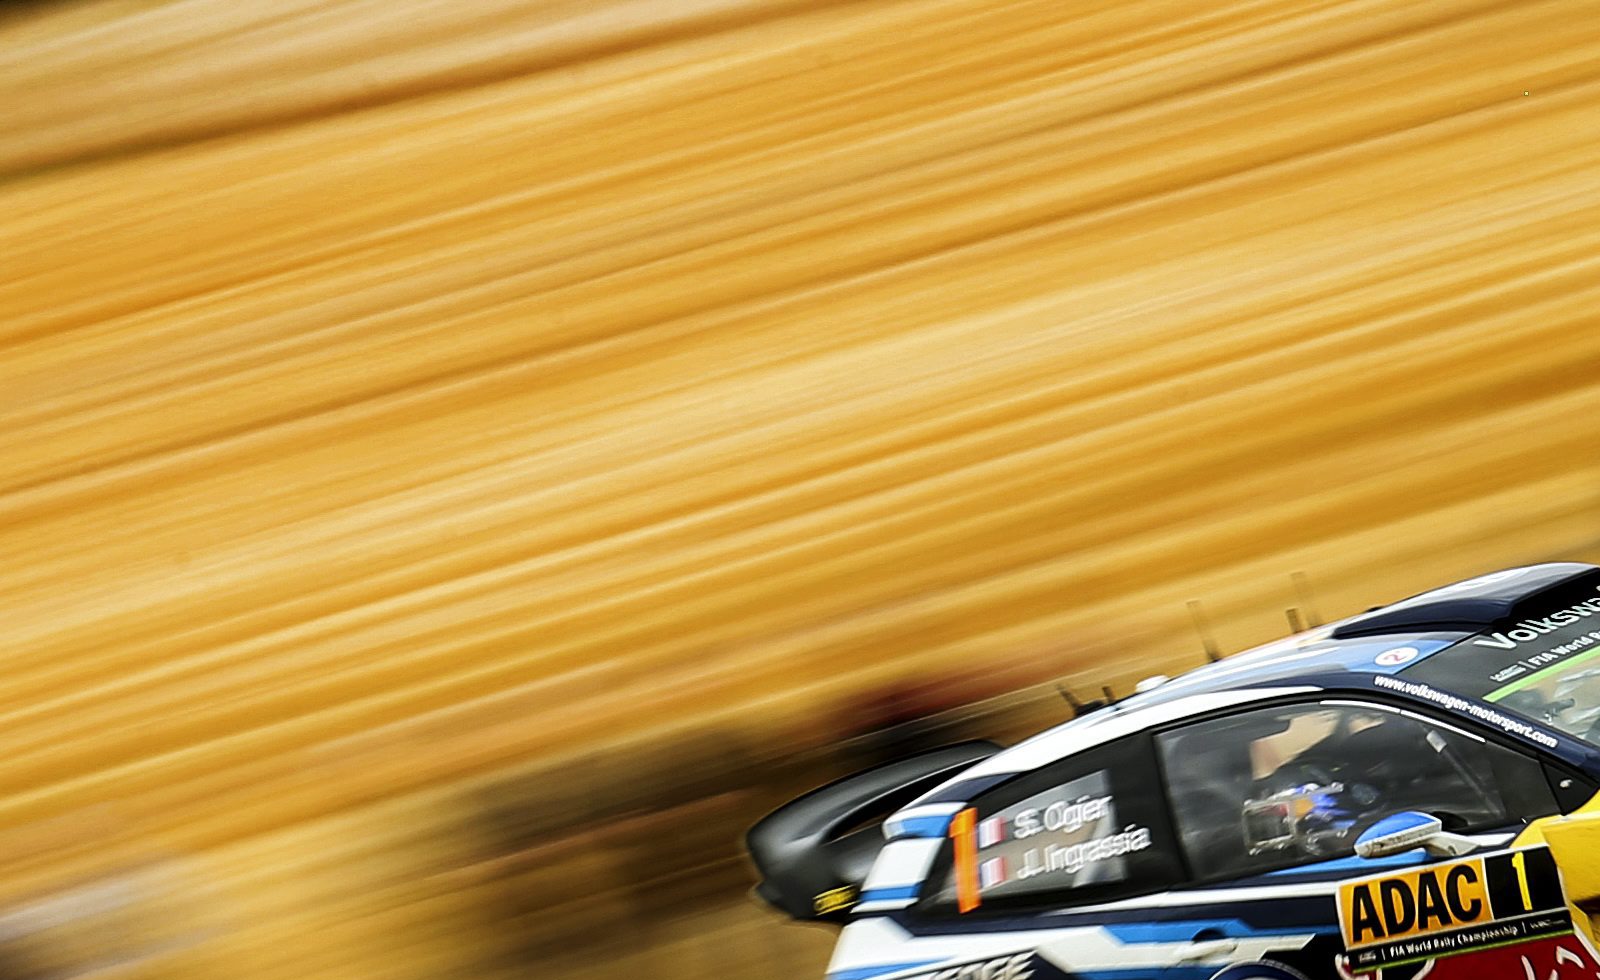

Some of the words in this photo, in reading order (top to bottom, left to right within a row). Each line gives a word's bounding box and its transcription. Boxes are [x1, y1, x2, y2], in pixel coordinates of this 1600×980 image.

[1550, 636, 1594, 655] World
[1374, 675, 1558, 748] www.volkswagen-motorsport.com
[1013, 808, 1043, 839] S.
[1044, 795, 1113, 833] Ogier
[949, 806, 982, 914] 1
[1017, 848, 1043, 880] J.
[1043, 824, 1152, 873] Ingrassia
[1352, 864, 1483, 943] ADAC
[1511, 851, 1533, 911] 1
[1405, 940, 1432, 954] World
